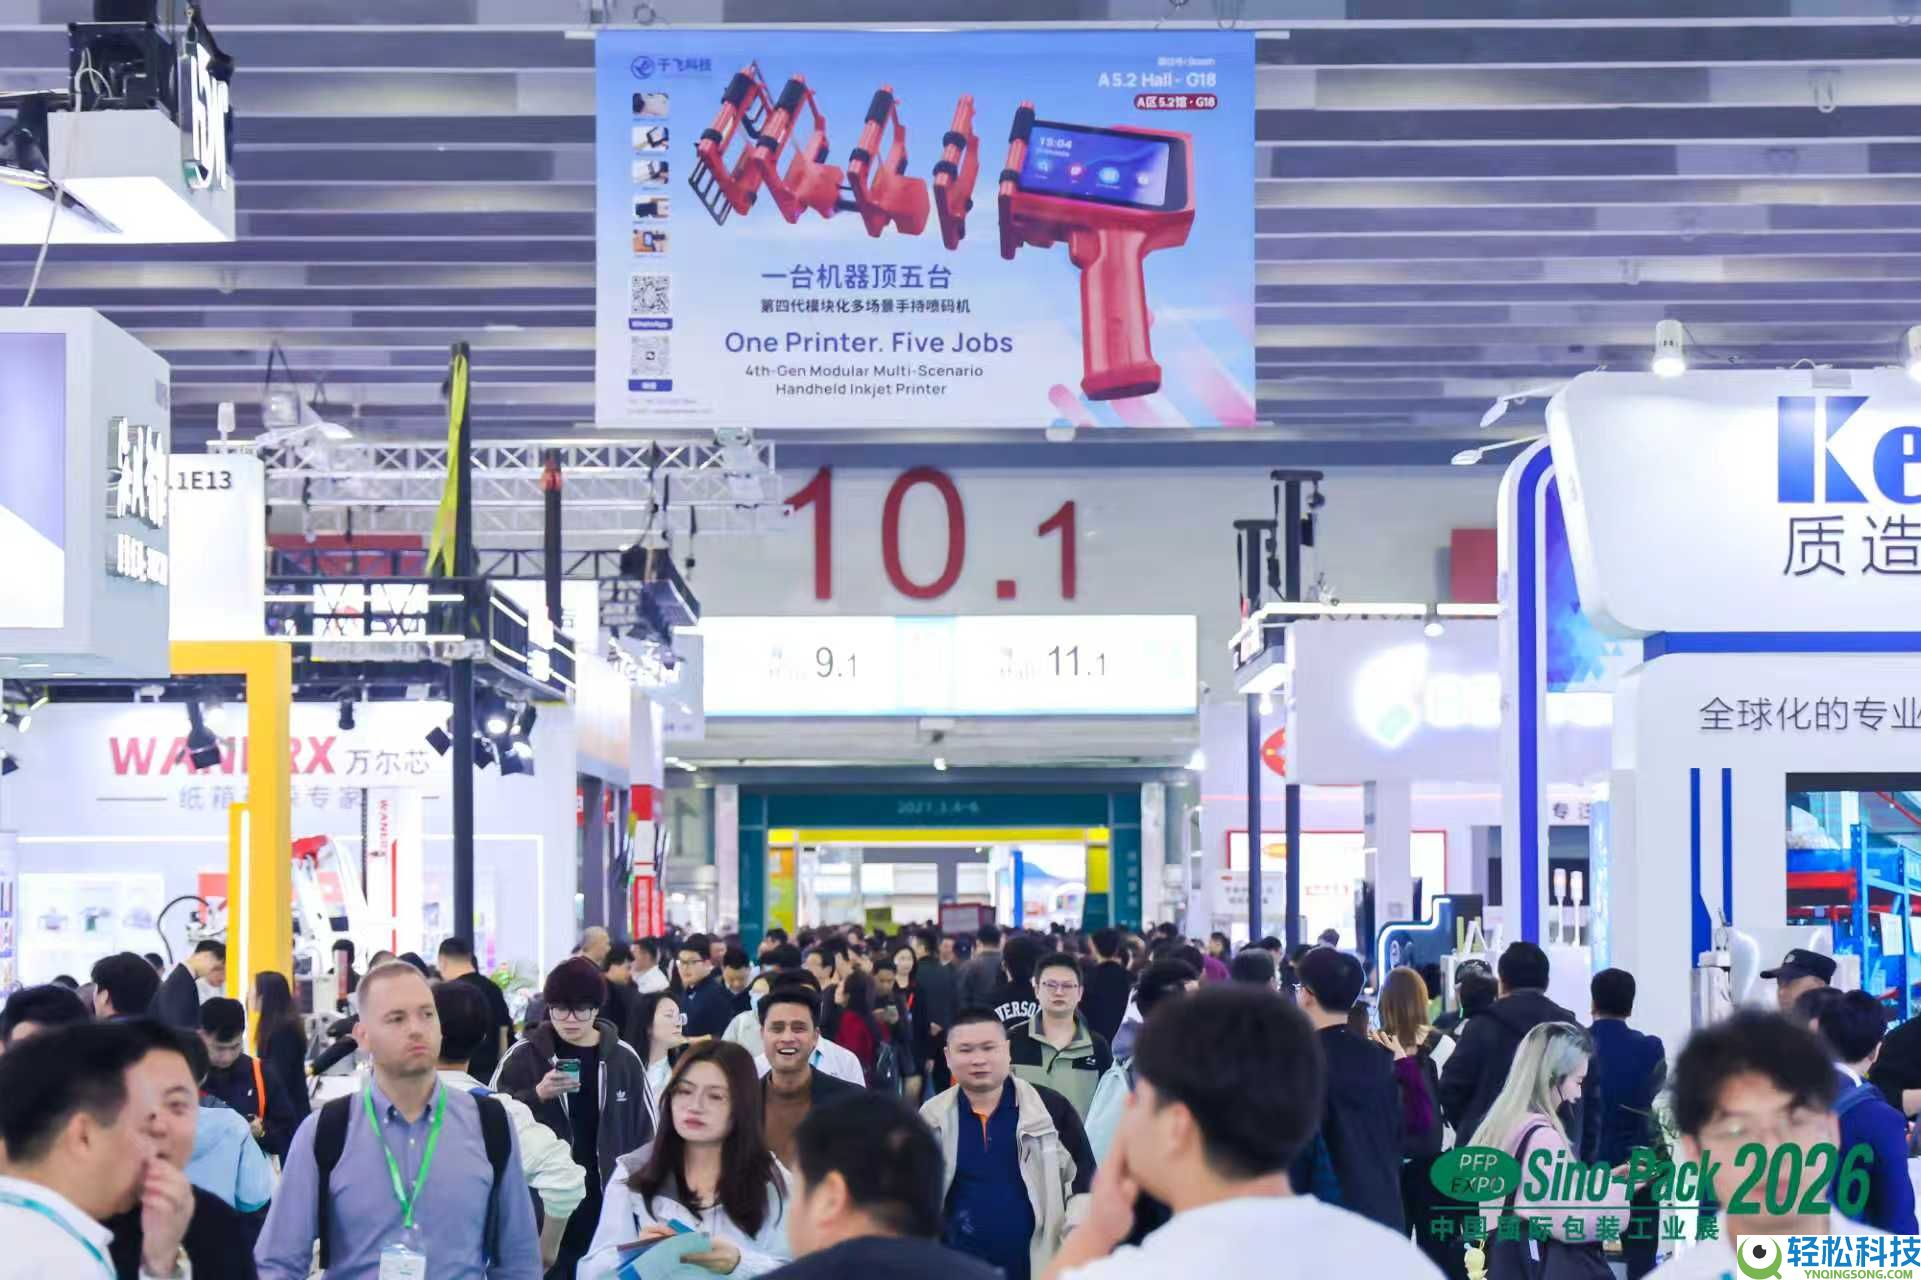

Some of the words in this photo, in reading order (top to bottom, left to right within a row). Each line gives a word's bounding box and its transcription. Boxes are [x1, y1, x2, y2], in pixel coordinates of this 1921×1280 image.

[1142, 72, 1172, 87] Hall
[1186, 72, 1217, 87] G18
[761, 263, 952, 289] 一台机器顶五台
[761, 299, 971, 313] 第四代模块化多场景手持喷码机
[725, 332, 778, 352] One
[786, 332, 884, 352] Printer.
[892, 332, 945, 352] Five
[952, 332, 1014, 353] Jobs
[745, 364, 806, 377] 4th-Gen
[809, 364, 870, 377] Modular
[873, 364, 984, 377] Multi-Scenario
[776, 383, 847, 396] Handheld
[850, 383, 893, 398] Inkjet
[896, 383, 947, 396] Printer
[784, 465, 1078, 601] 10.1
[1783, 514, 1921, 577] 质造
[815, 646, 857, 678] 9.1
[1047, 645, 1106, 677] 11.1
[1699, 696, 1921, 732] 全球化的专业
[345, 748, 430, 775] 万尔芯
